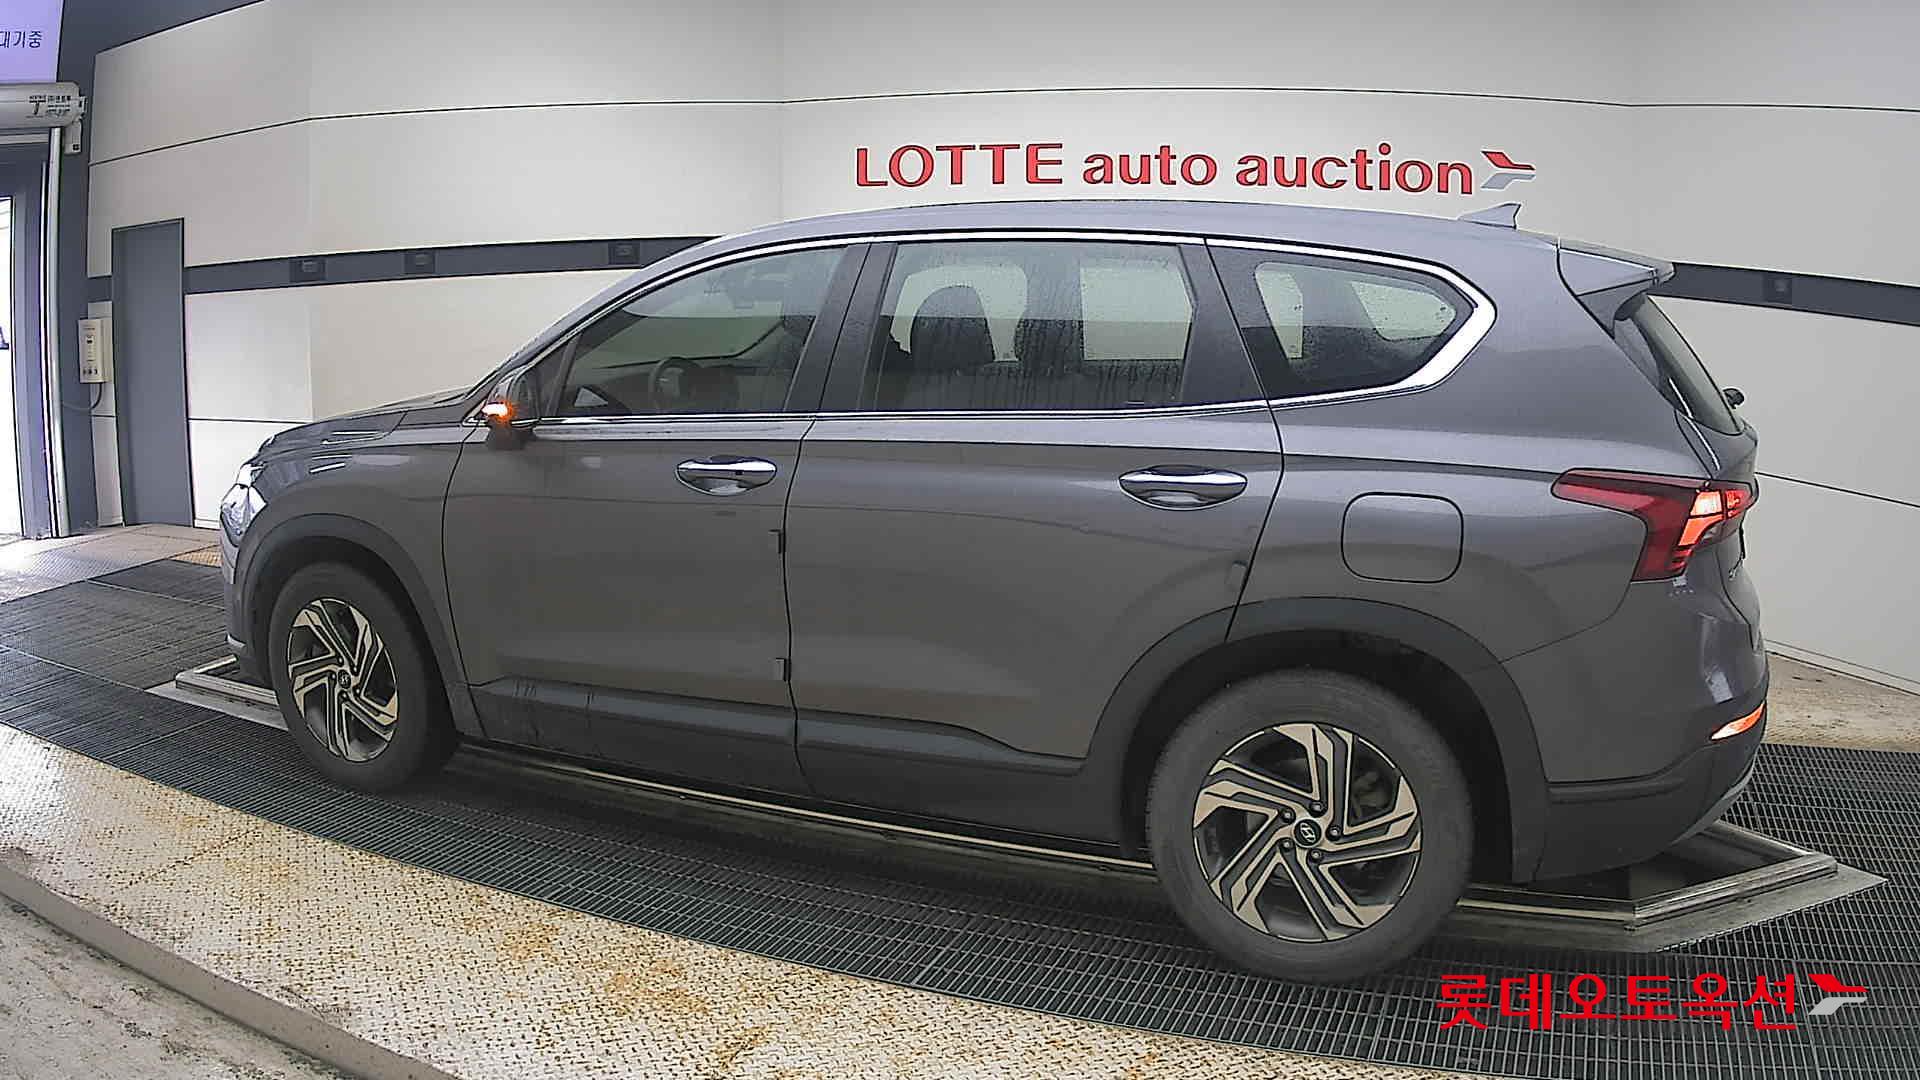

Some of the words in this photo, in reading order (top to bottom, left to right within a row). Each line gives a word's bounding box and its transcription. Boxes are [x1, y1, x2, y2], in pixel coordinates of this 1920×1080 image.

[0, 30, 42, 48] 대기중
[856, 143, 1064, 187] LOTTE
[1083, 145, 1218, 186] auto
[1236, 143, 1473, 194] auction
